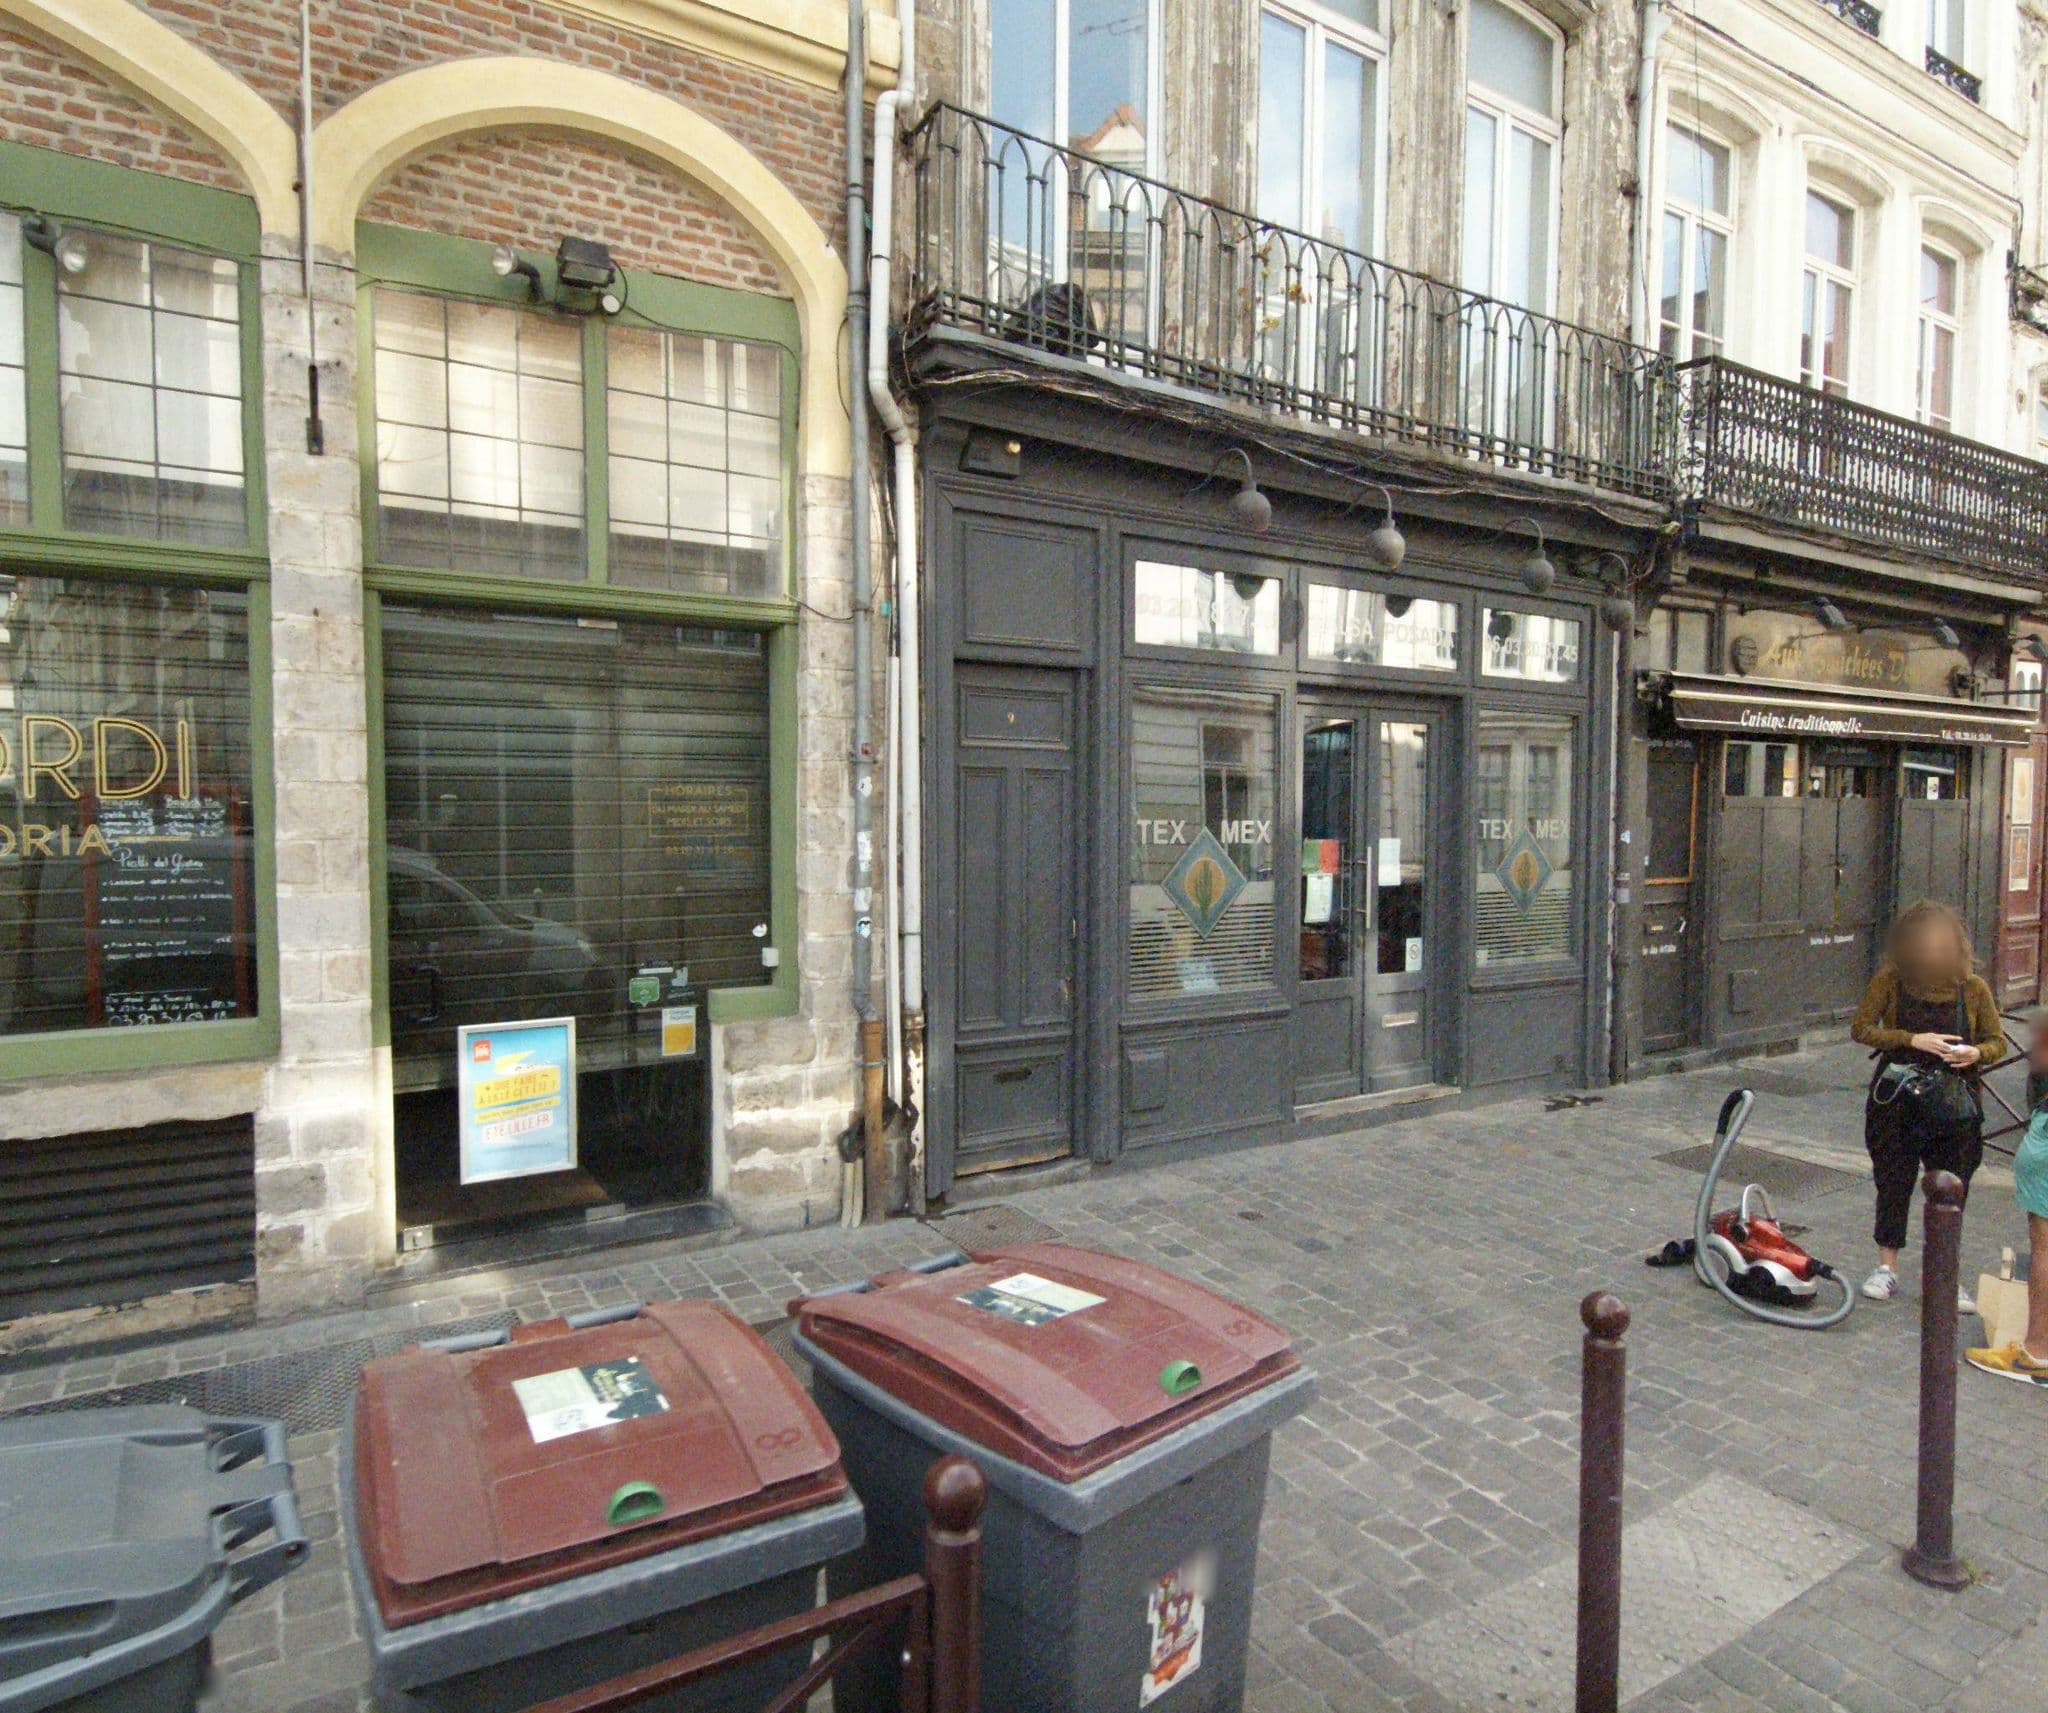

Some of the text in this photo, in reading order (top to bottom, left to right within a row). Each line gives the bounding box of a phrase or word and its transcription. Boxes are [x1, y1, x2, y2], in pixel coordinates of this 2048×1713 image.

[1740, 709, 1785, 731] Cuisine
[0, 715, 190, 800] RDI
[1136, 819, 1271, 845] TEX MEX
[1479, 819, 1570, 840] TEX MEX
